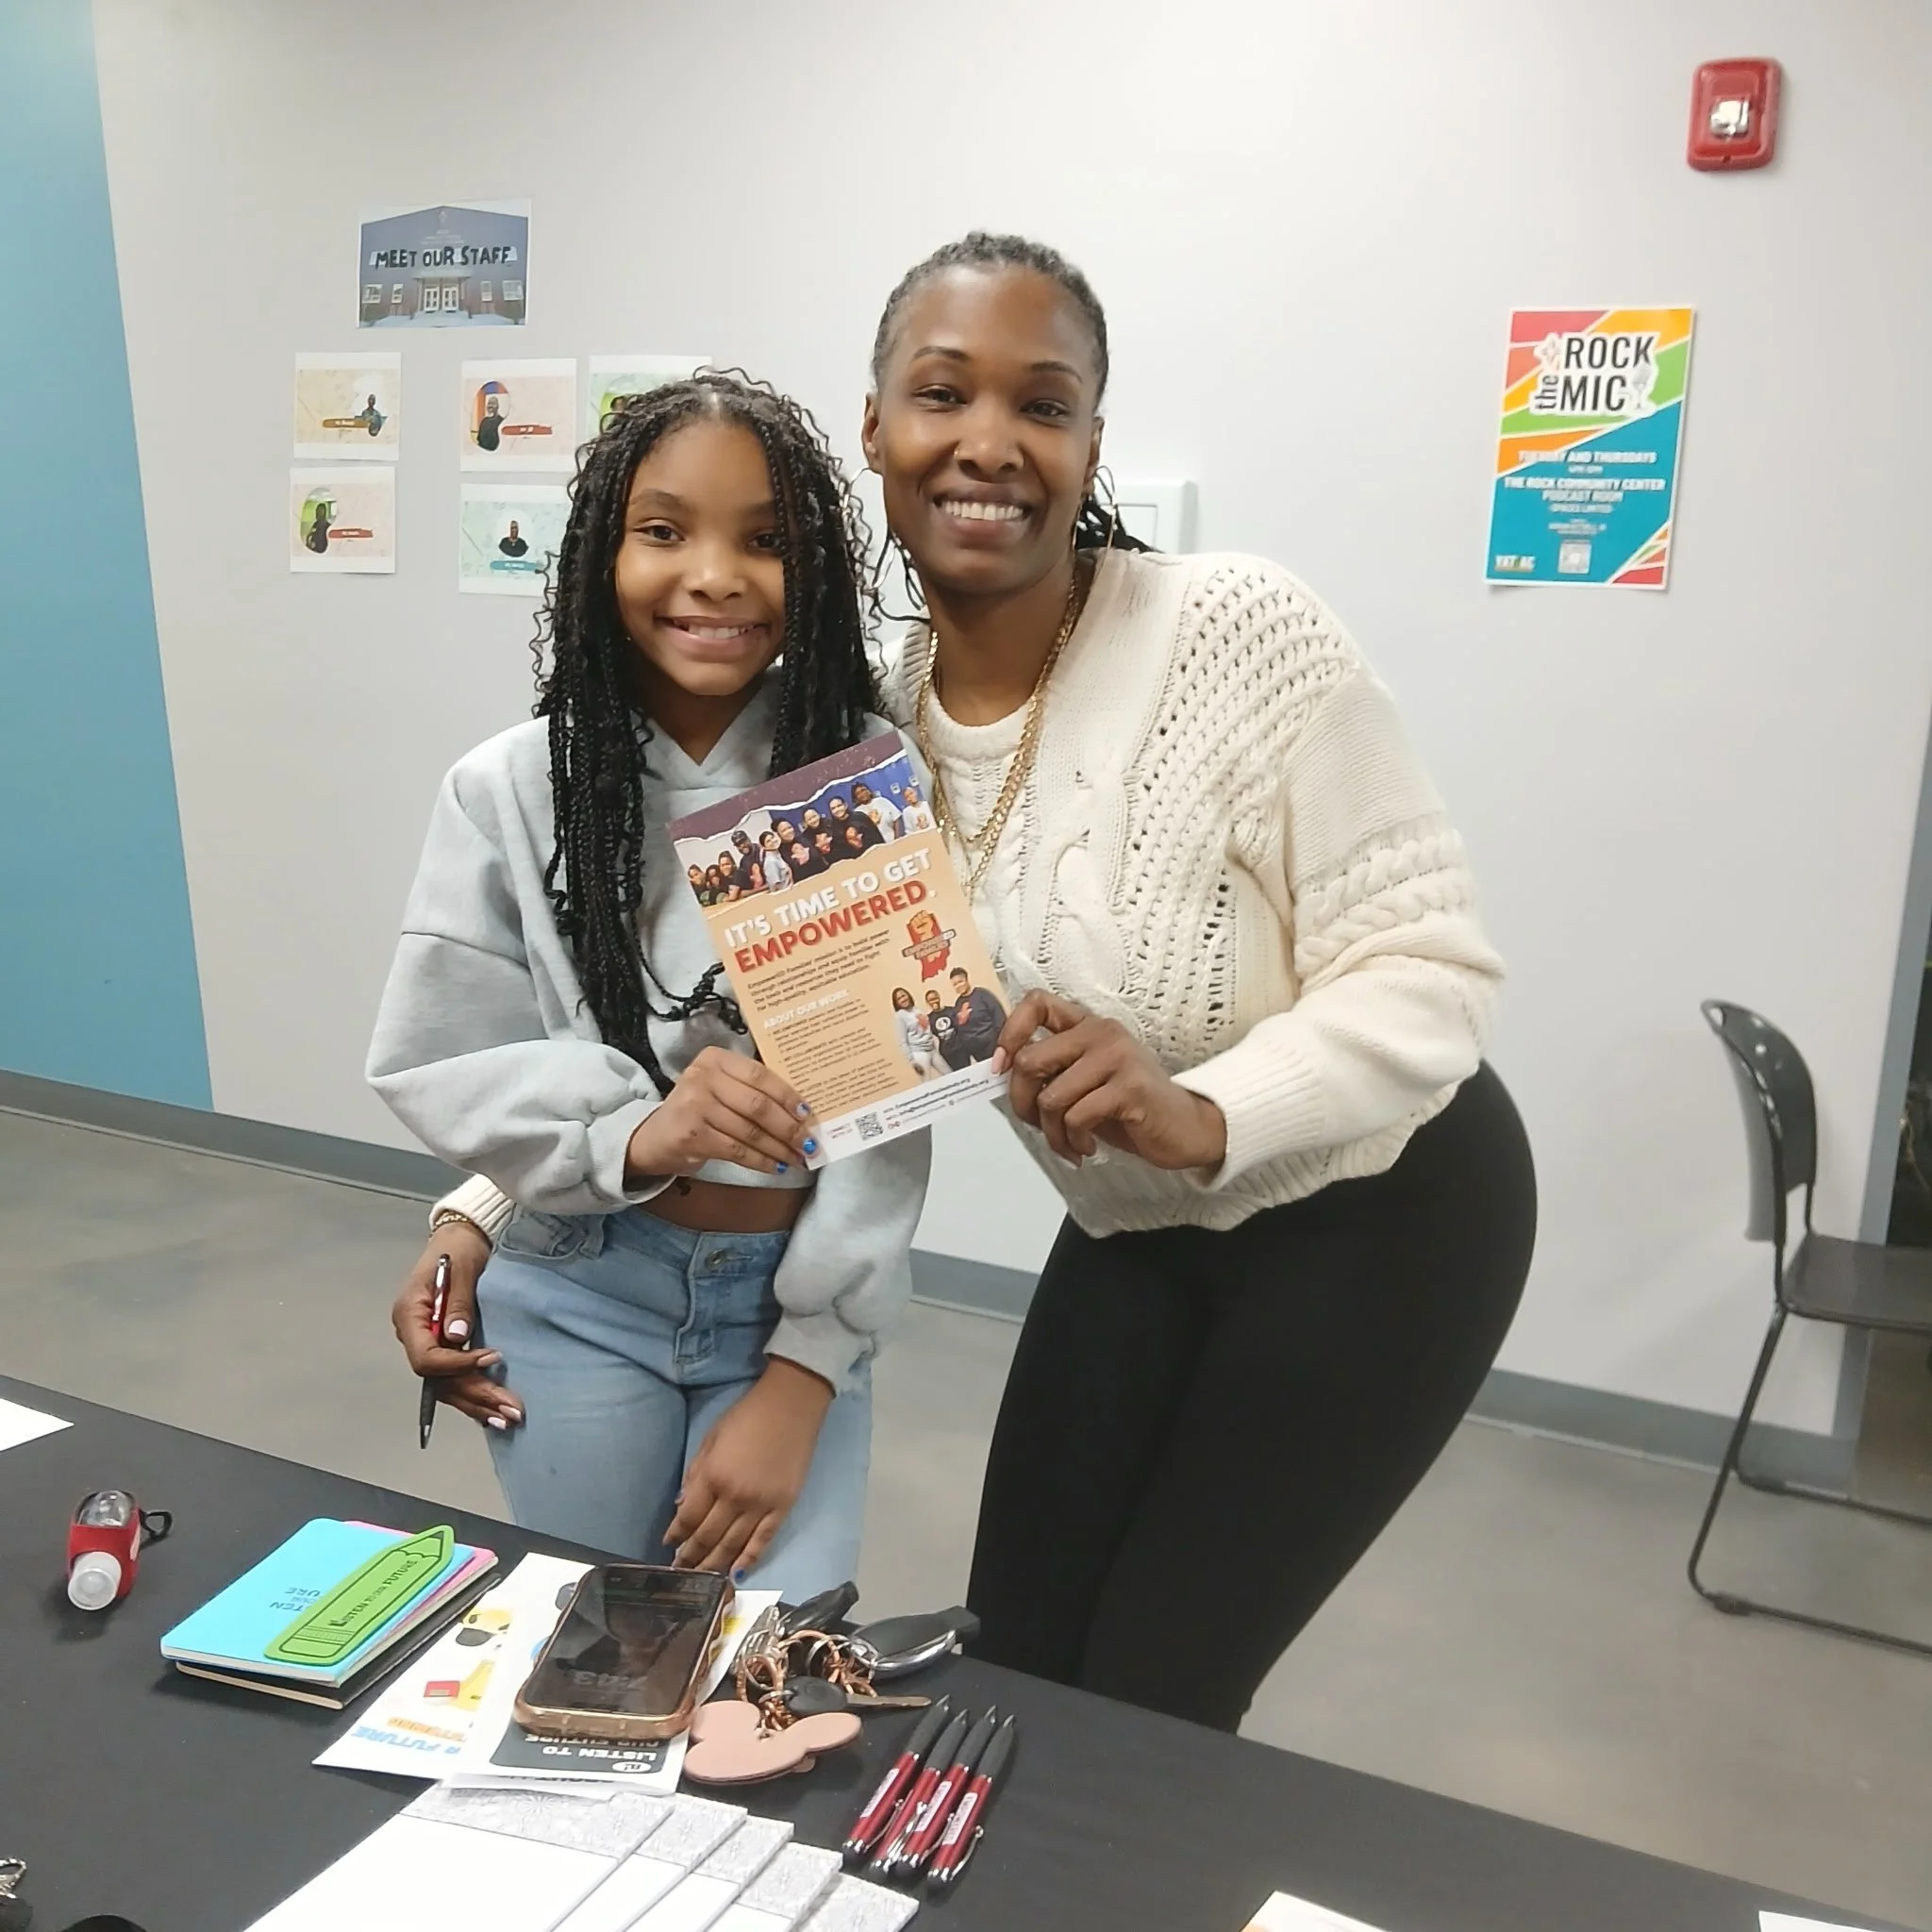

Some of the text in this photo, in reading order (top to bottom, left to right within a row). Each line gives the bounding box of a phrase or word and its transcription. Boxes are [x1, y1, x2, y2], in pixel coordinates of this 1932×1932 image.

[375, 245, 511, 270] MEET OUR STAFF
[1564, 336, 1655, 370] ROCK
[1535, 375, 1627, 411] the MIC
[724, 847, 932, 948] IT'S TIME TO GET
[735, 880, 938, 974] EMPOWERED.
[764, 1008, 794, 1029] ABOUT
[795, 999, 818, 1016] OUR
[818, 990, 849, 1008] WORK
[382, 1559, 418, 1586] FUTURE
[351, 1725, 441, 1751] FUTURE
[542, 1745, 658, 1761] LISTEN TO
